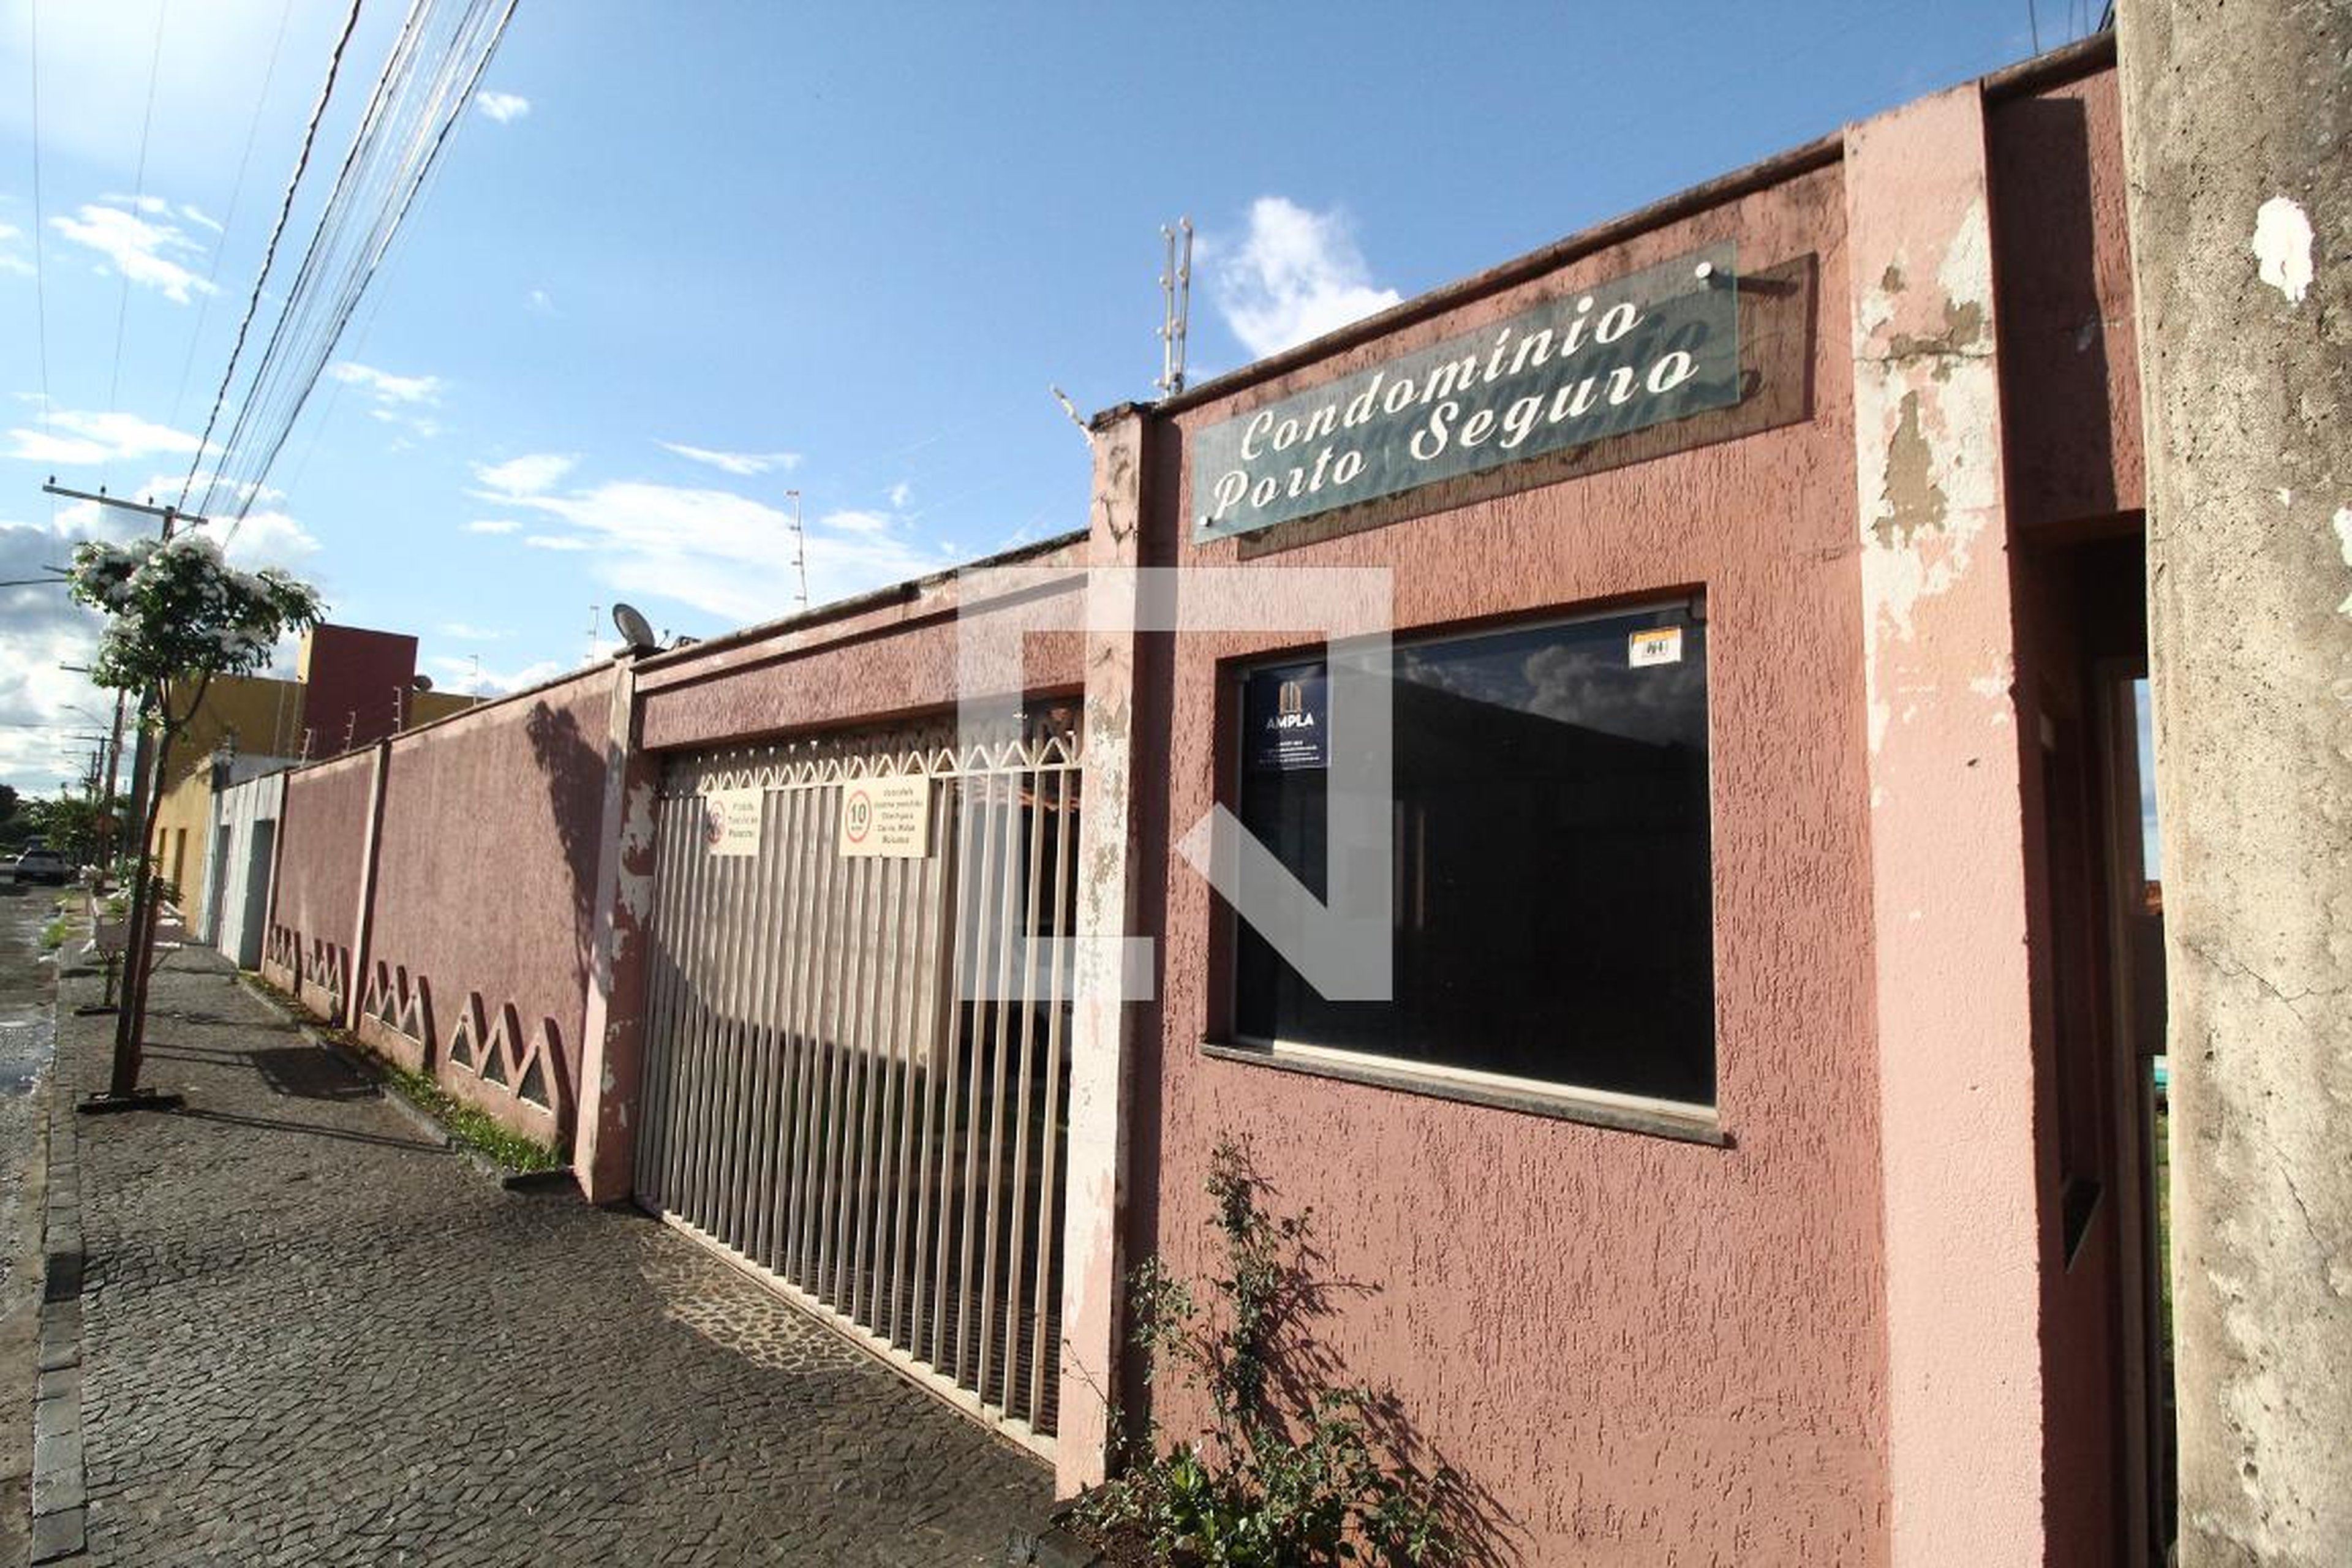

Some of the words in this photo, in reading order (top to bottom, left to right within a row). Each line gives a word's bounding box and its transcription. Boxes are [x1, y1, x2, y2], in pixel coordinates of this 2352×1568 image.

[1241, 296, 1646, 461] Condomínio
[1213, 446, 1367, 519] Porto
[1411, 351, 1699, 461] Seguro
[1267, 712, 1314, 729] AMPLA
[852, 803, 866, 823] 10
